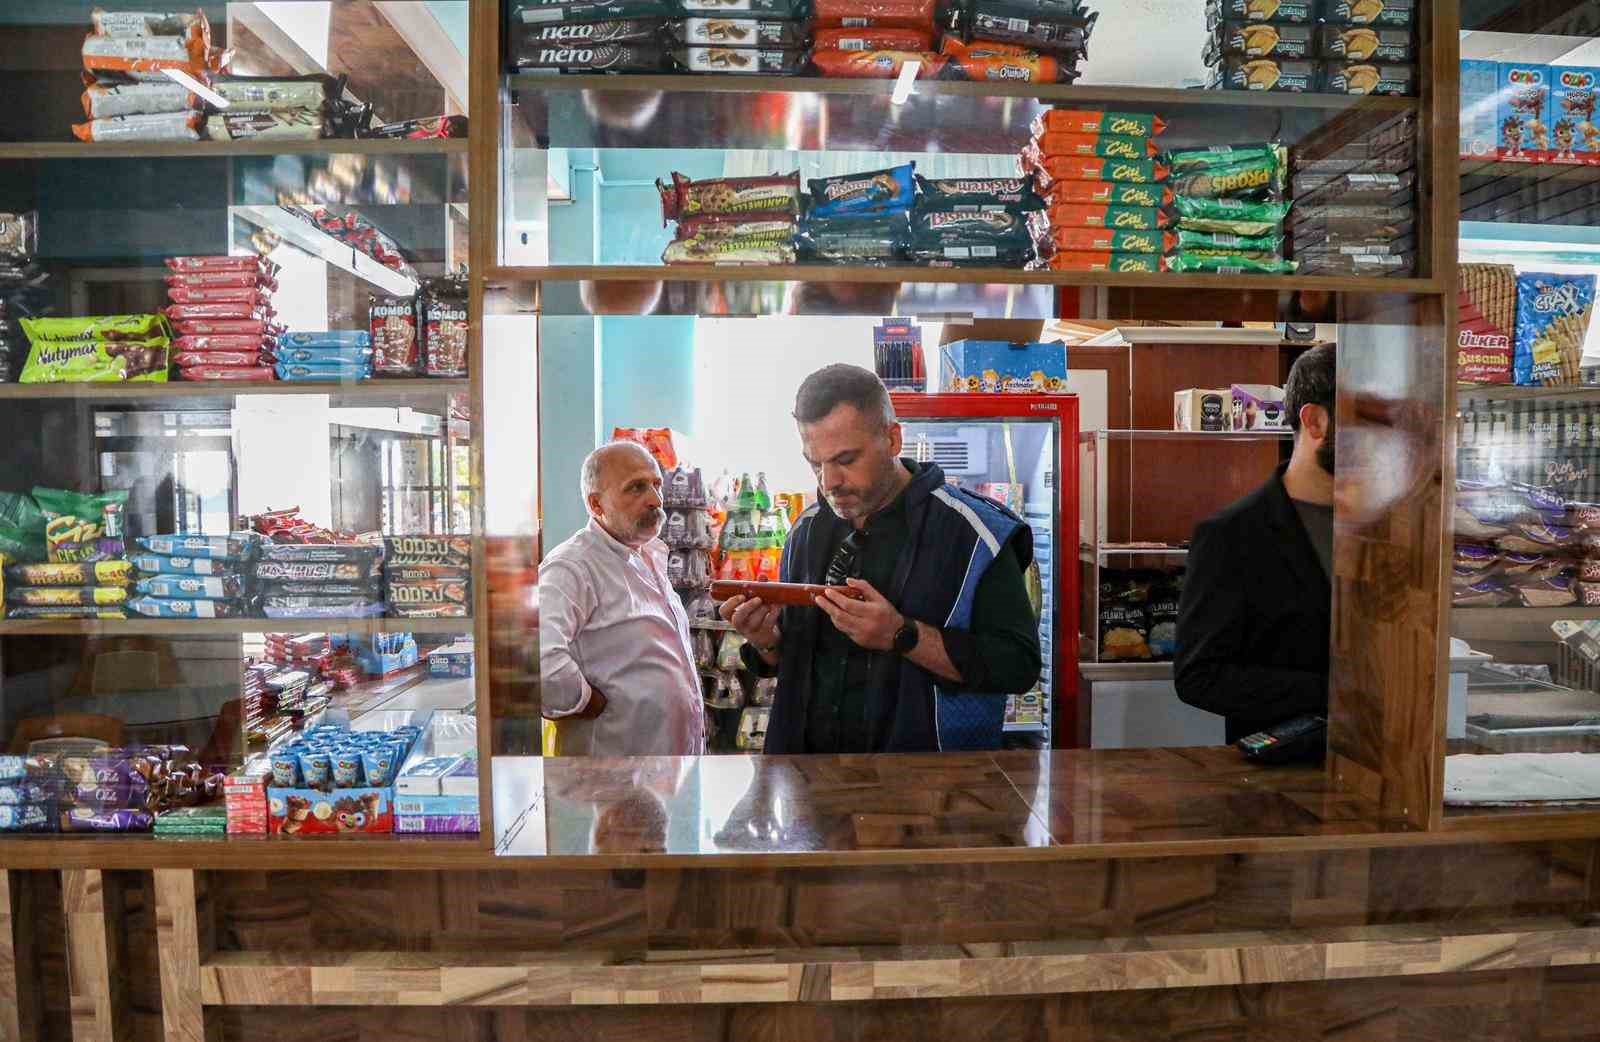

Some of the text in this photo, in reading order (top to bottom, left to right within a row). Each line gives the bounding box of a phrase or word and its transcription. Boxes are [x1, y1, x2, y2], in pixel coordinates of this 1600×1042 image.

[540, 24, 593, 40] nero
[539, 48, 593, 63] nero
[374, 306, 412, 316] KOMBO
[427, 310, 467, 320] KOMBO
[1460, 331, 1509, 348] ÜLKER
[37, 343, 98, 366] Nutymax
[392, 538, 449, 554] RODEO
[390, 588, 444, 602] RODEO
